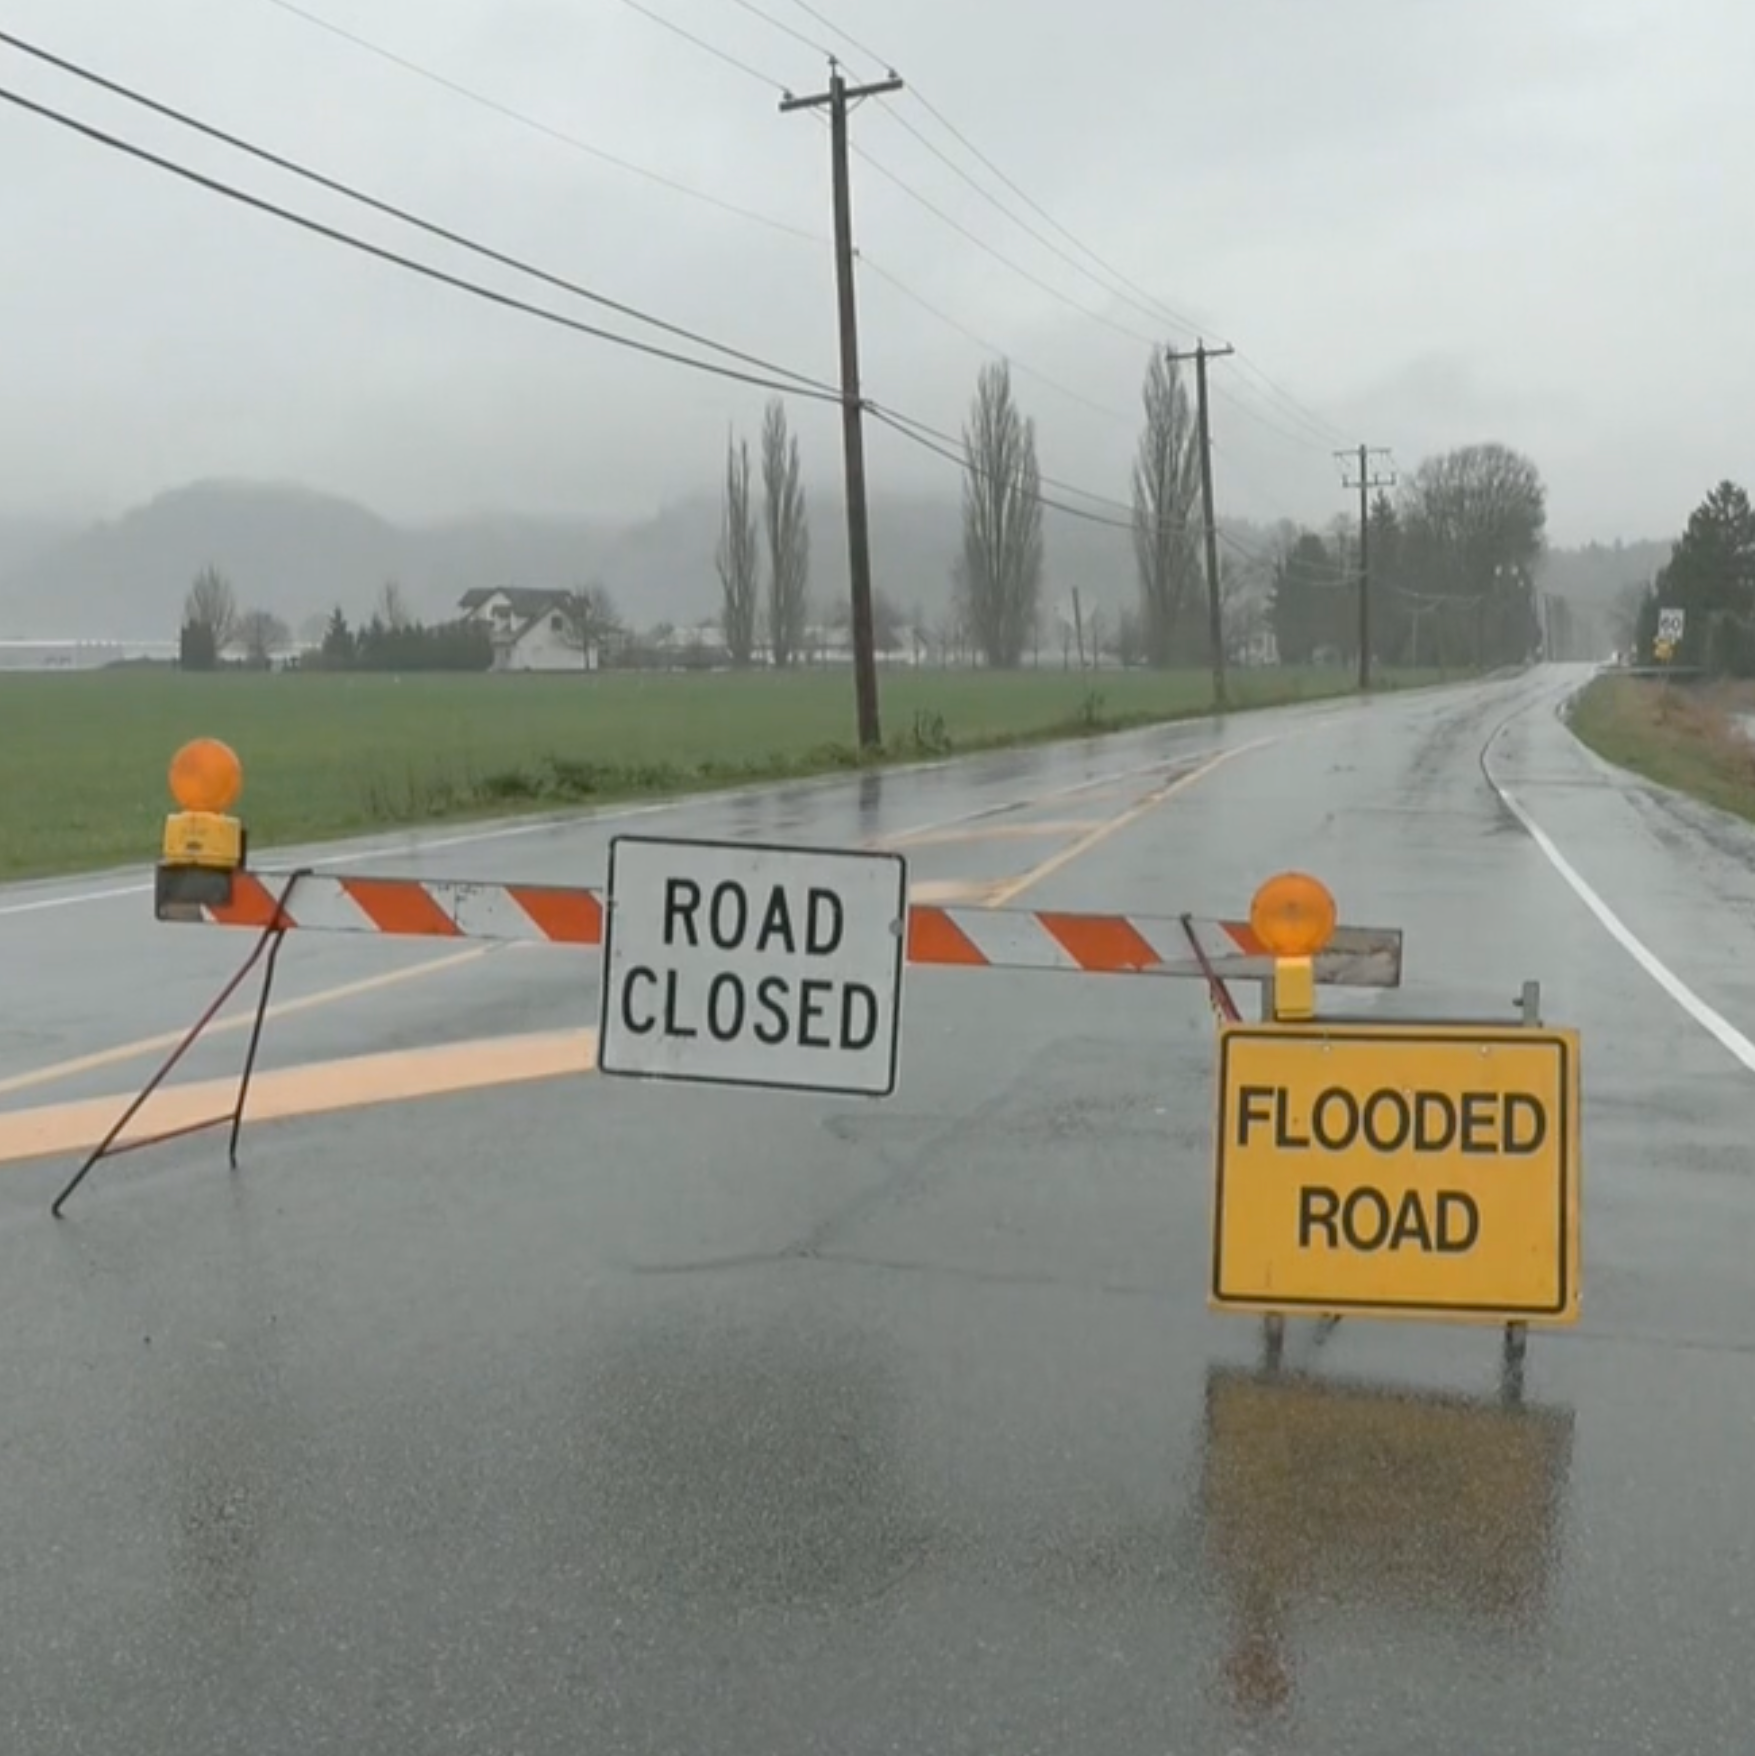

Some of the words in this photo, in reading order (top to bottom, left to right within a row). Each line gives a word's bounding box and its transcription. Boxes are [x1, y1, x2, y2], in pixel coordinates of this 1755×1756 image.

[663, 877, 844, 956] ROAD
[621, 965, 878, 1051] CLOSED
[1237, 1086, 1546, 1154] FLOODED
[1299, 1186, 1479, 1253] ROAD
